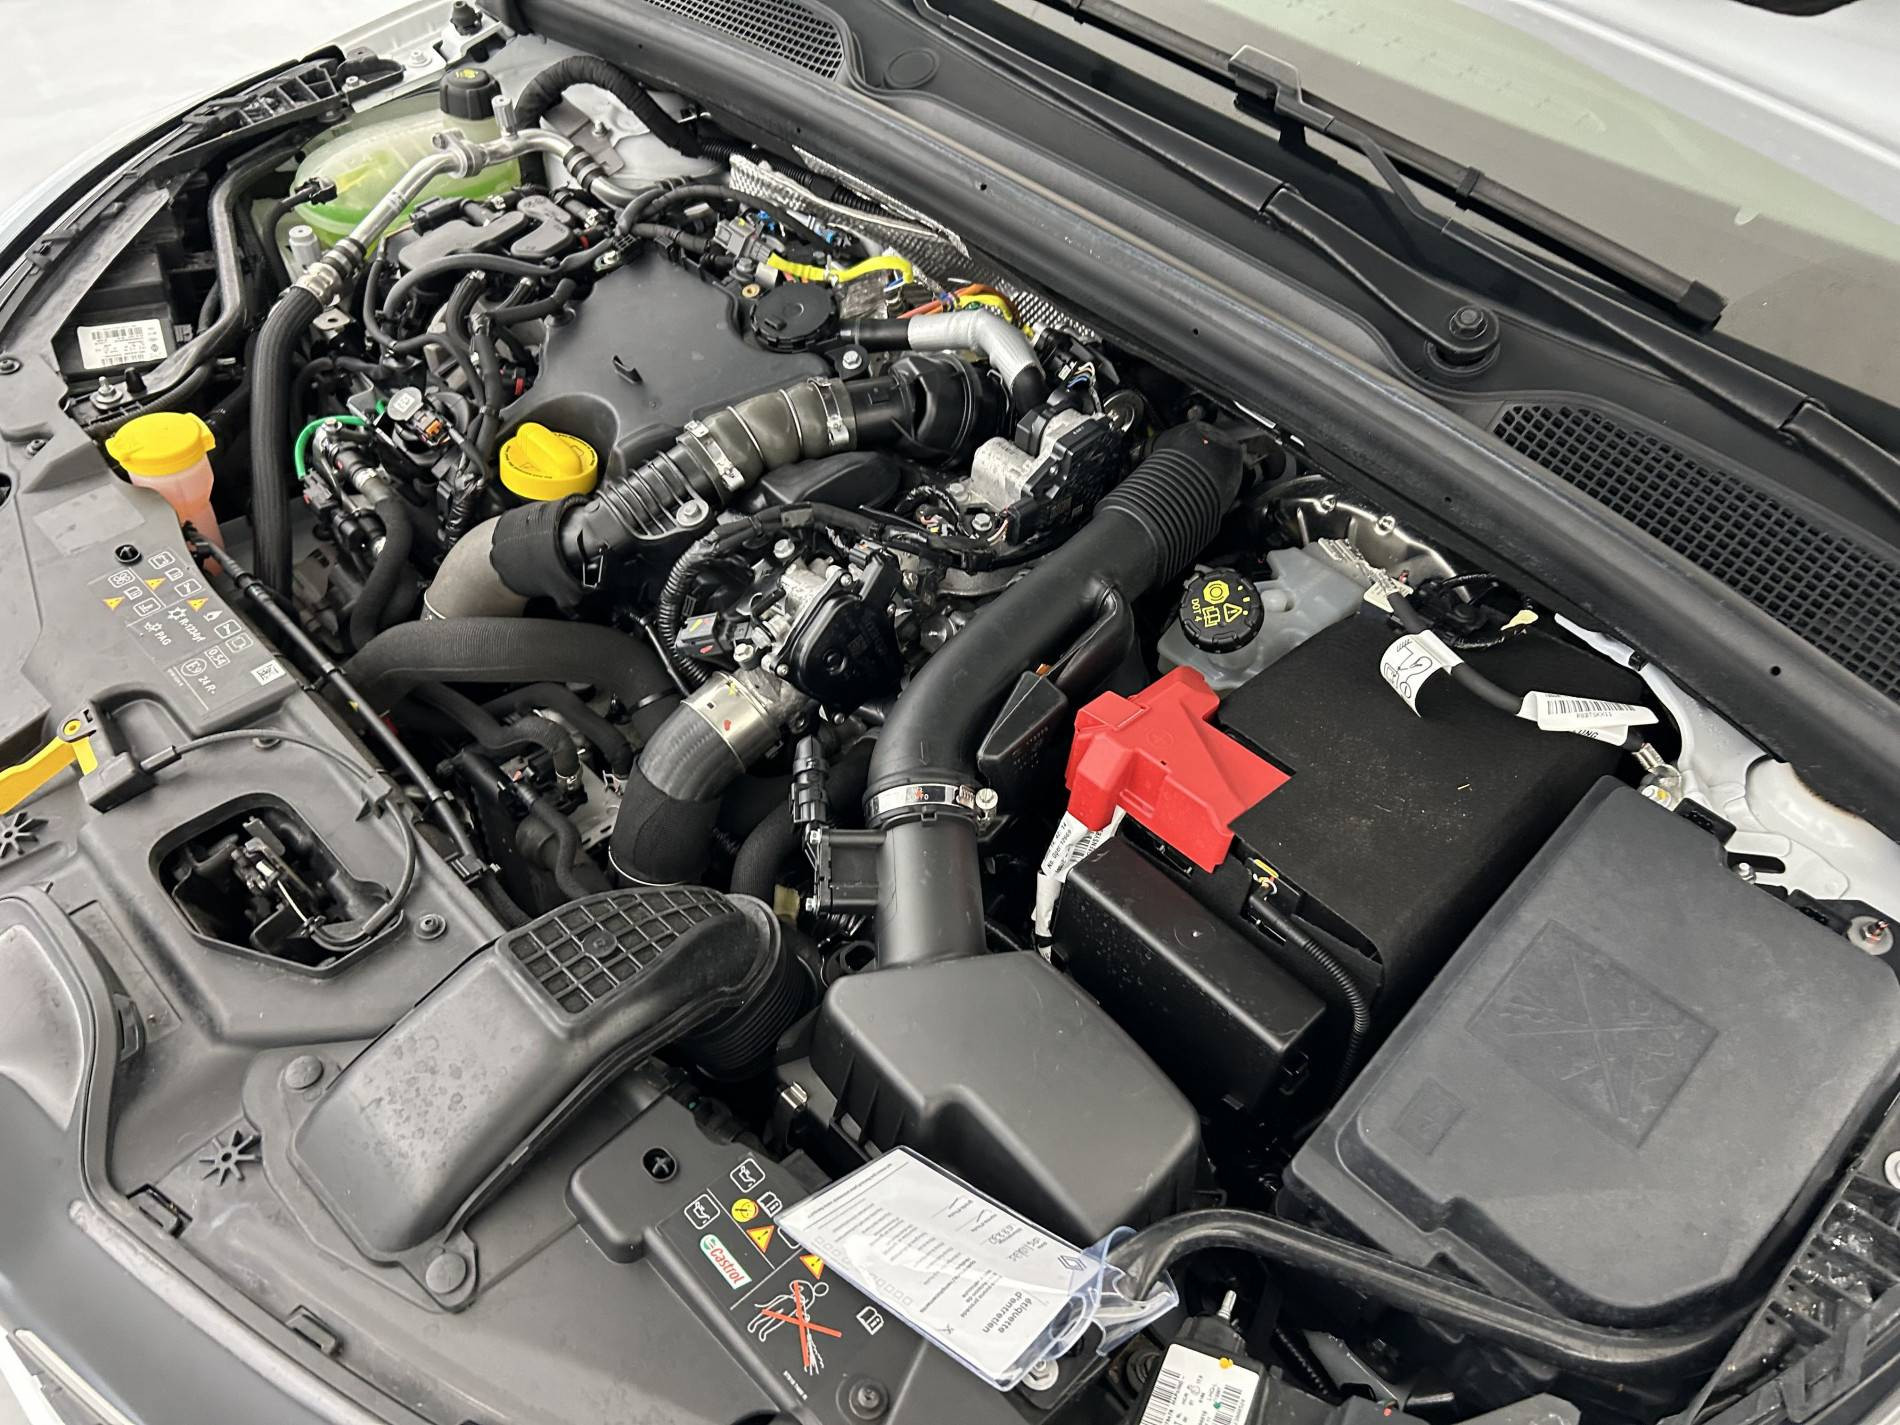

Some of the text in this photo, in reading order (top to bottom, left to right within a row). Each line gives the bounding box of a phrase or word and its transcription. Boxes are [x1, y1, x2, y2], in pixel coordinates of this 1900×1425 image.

[1192, 598, 1201, 615] DOT
[155, 631, 172, 646] PAG
[710, 1247, 745, 1285] Castrol
[982, 1291, 1023, 1334] d'entretien
[998, 1297, 1033, 1334] étiquette
